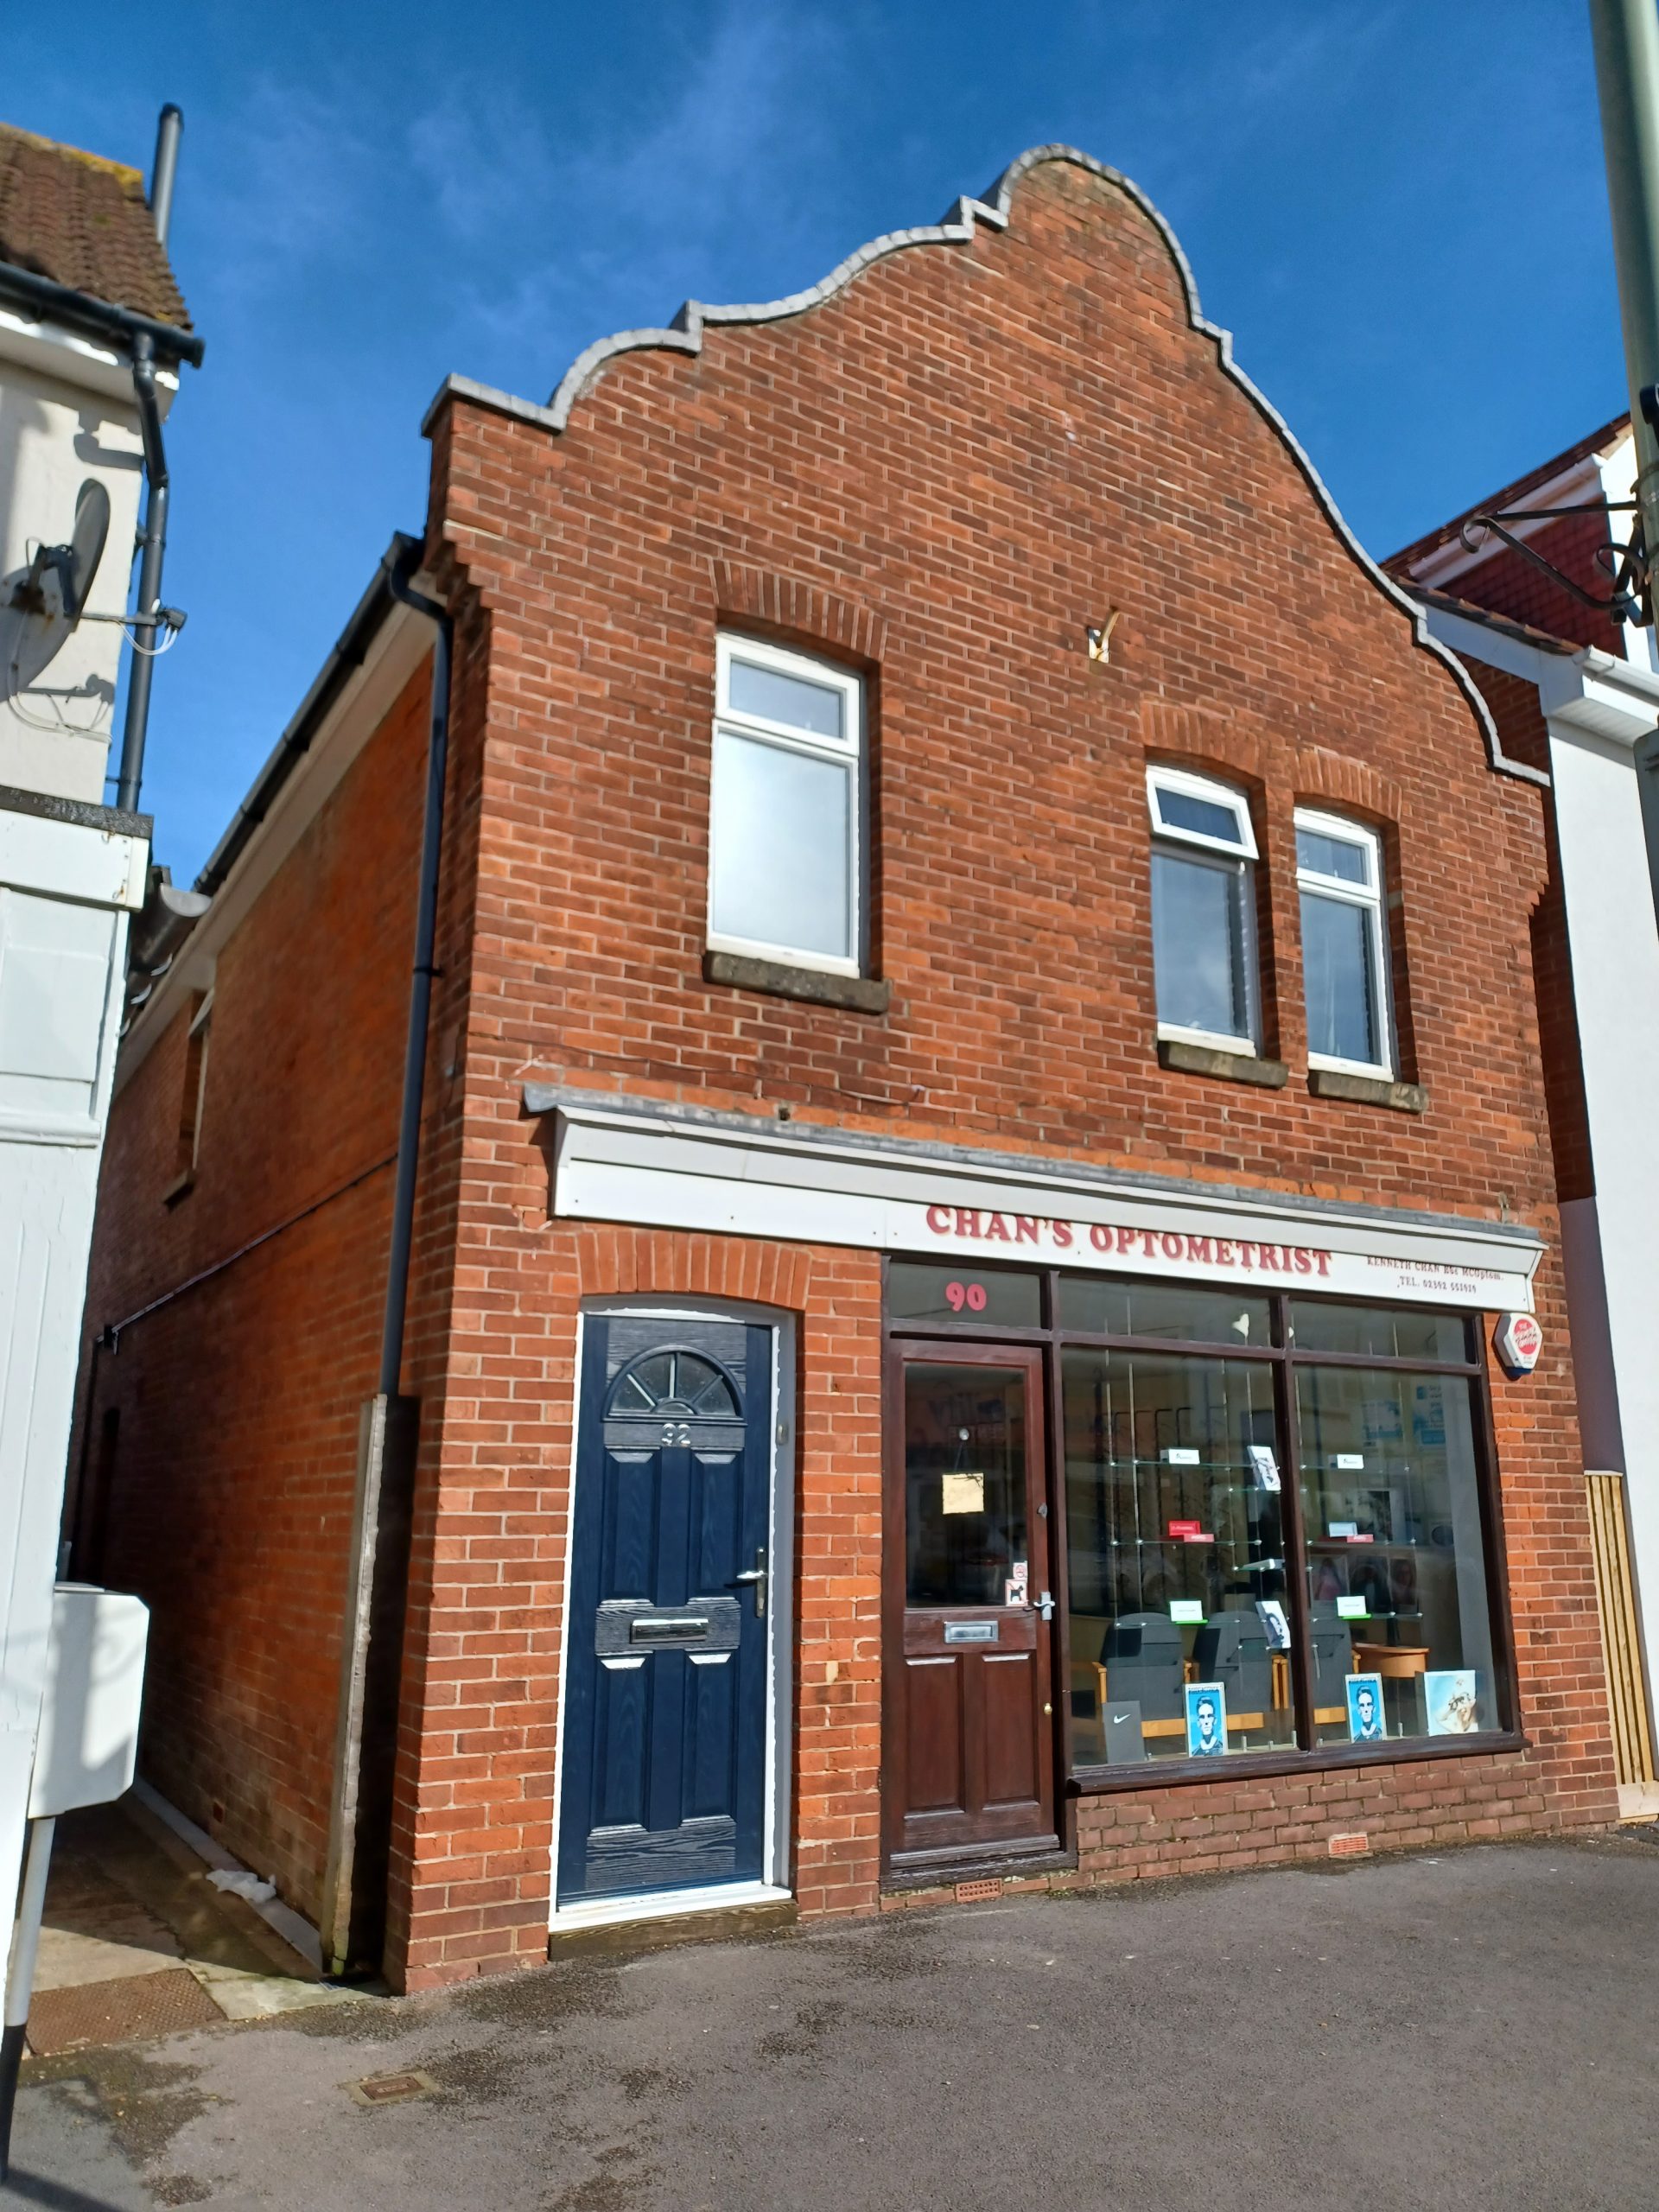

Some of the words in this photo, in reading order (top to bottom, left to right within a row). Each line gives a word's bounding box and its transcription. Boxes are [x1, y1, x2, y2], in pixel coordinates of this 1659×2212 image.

[926, 1205, 1073, 1248] CHAN'S
[1090, 1224, 1332, 1275] OPTOMETRIST
[1414, 1262, 1440, 1273] CHAN
[945, 1281, 987, 1312] 90
